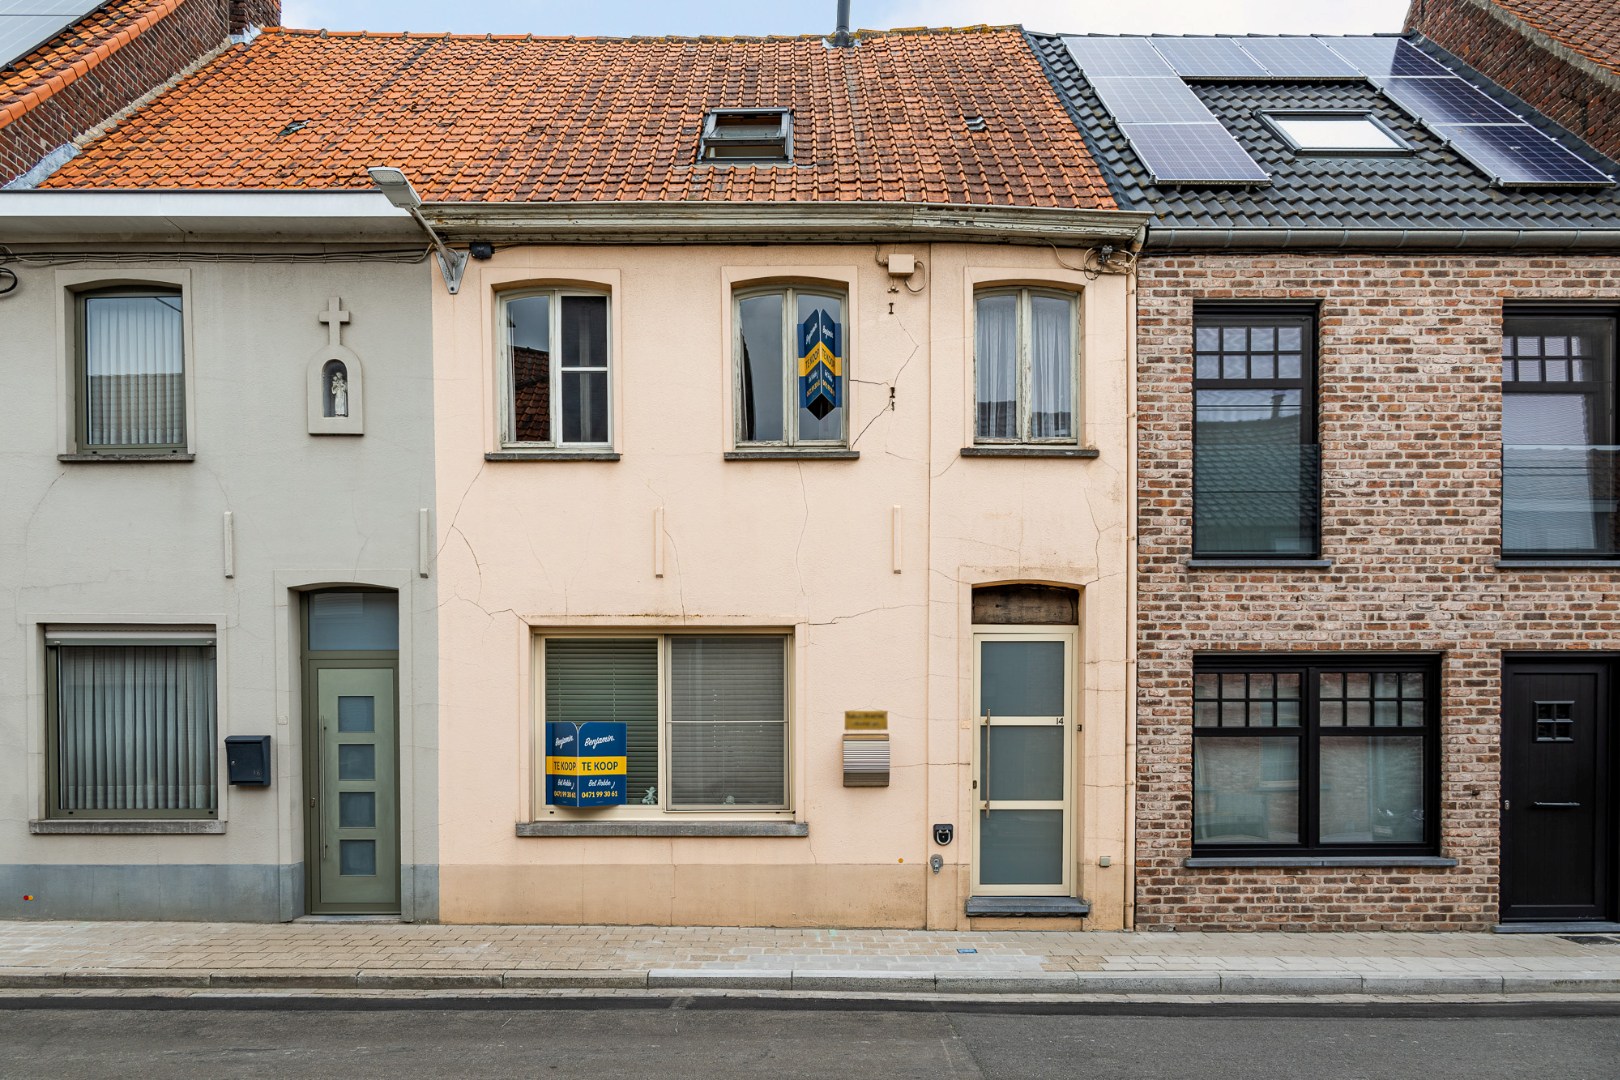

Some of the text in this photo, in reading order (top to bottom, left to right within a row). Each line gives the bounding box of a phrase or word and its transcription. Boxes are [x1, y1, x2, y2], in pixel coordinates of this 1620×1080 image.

[554, 762, 576, 770] TE KOOP
[582, 762, 618, 771] TE KOOP
